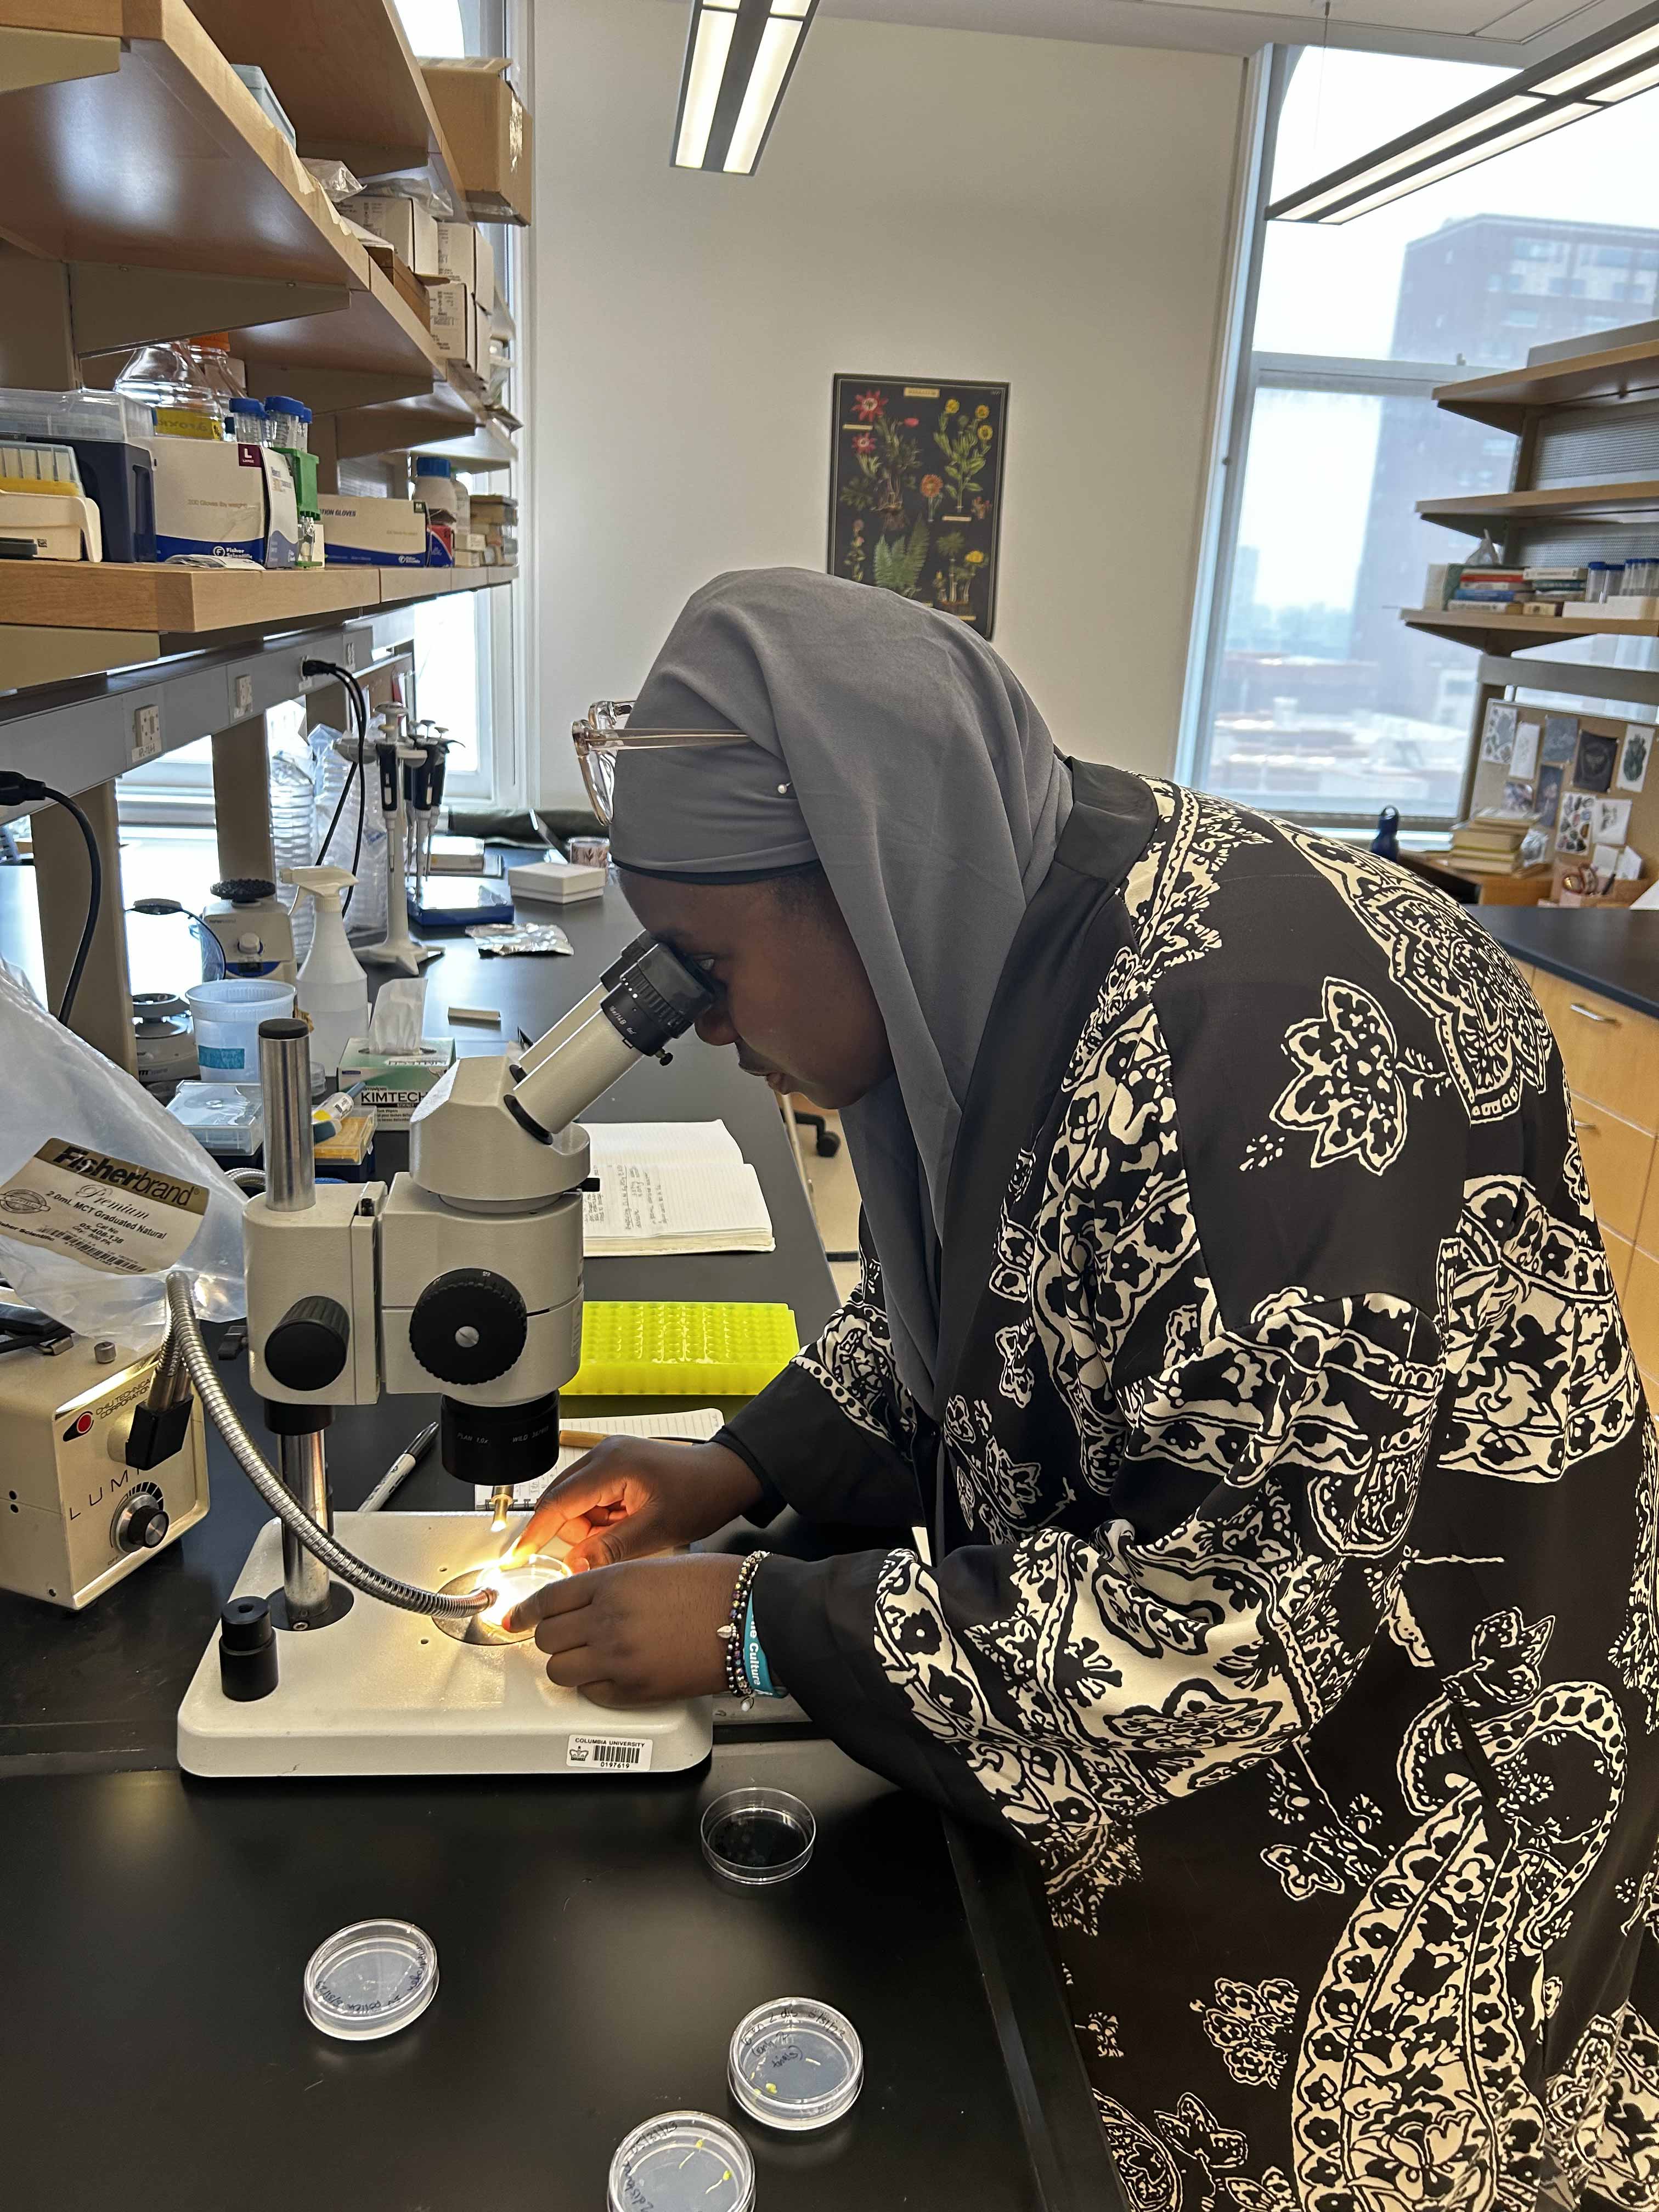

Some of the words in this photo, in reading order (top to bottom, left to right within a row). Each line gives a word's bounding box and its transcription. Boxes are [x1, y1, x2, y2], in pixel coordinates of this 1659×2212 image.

[244, 448, 252, 458] L
[361, 1092, 428, 1102] KIMTECH
[75, 1184, 150, 1220] Premium
[74, 1201, 95, 1214] MCT
[94, 1210, 138, 1229] Graduated
[137, 1223, 167, 1239] Natural
[0, 1221, 19, 1232] isher
[19, 1228, 55, 1242] Scientific
[115, 1379, 150, 1402] TECHNICA
[456, 1432, 473, 1441] PLAN
[512, 1434, 528, 1442] WILD
[749, 1642, 761, 1686] Culture
[347, 2000, 381, 2011] pollen
